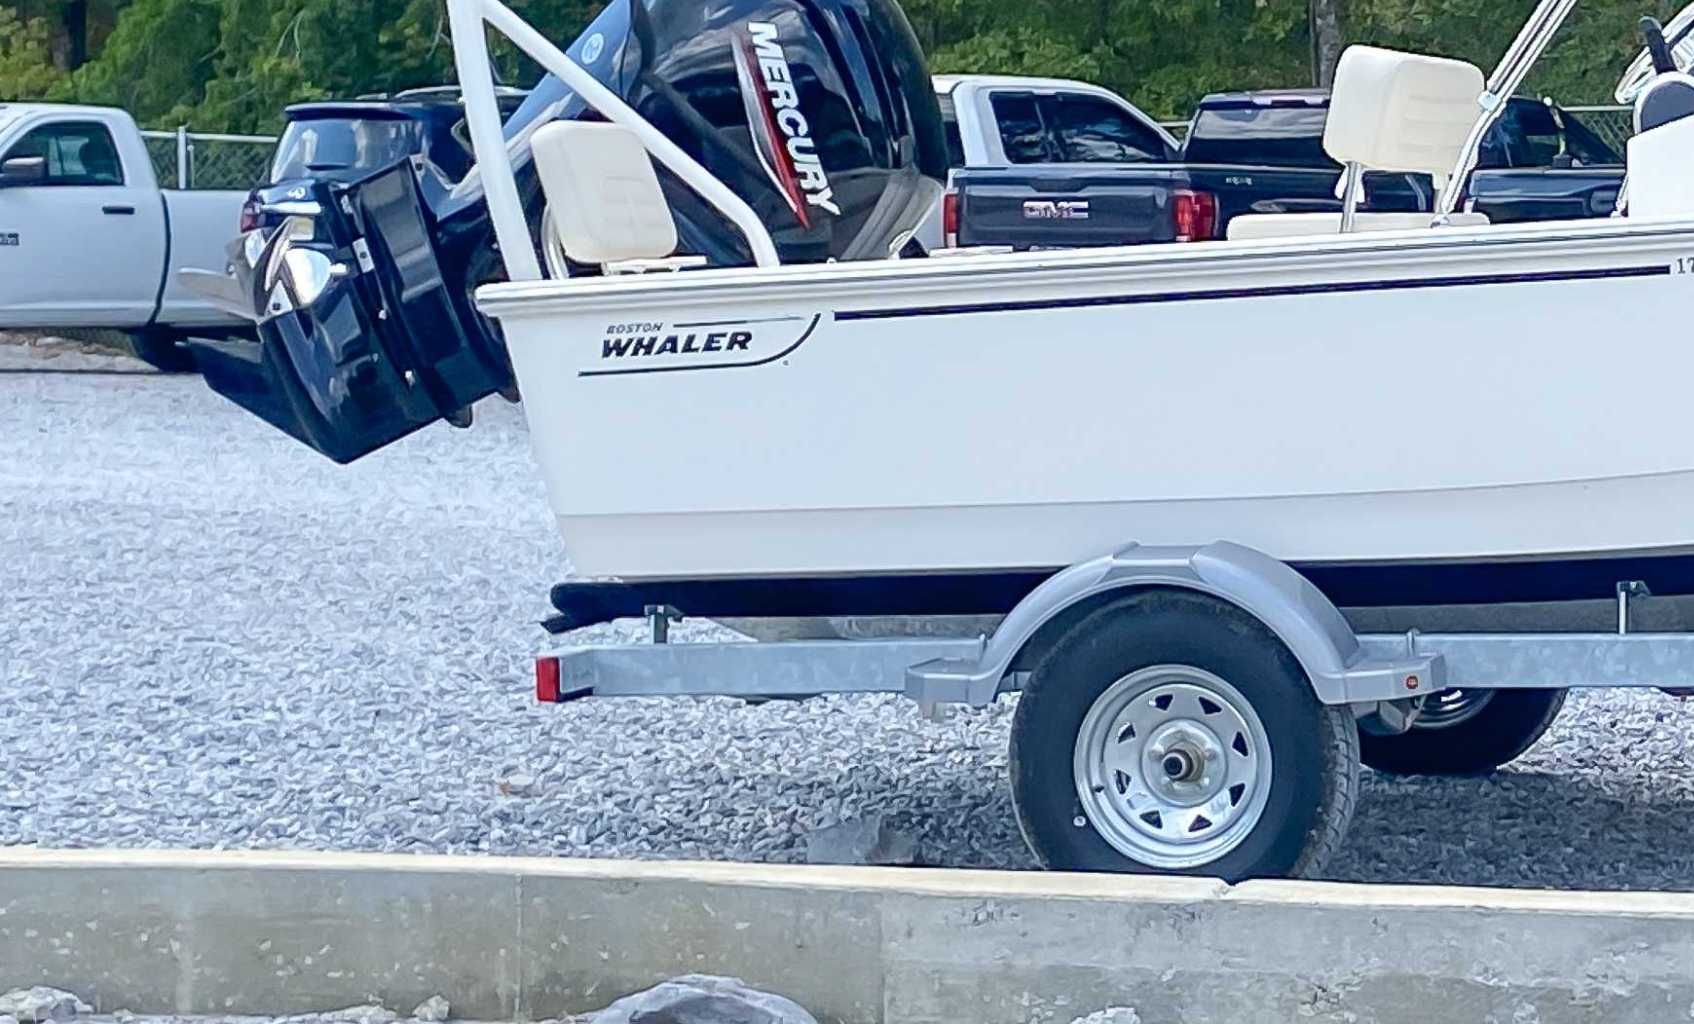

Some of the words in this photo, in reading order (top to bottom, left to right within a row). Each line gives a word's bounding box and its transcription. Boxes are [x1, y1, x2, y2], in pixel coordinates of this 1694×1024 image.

[748, 22, 841, 215] MERCURY
[606, 322, 663, 334] BOSTON
[602, 331, 752, 358] WHALER
